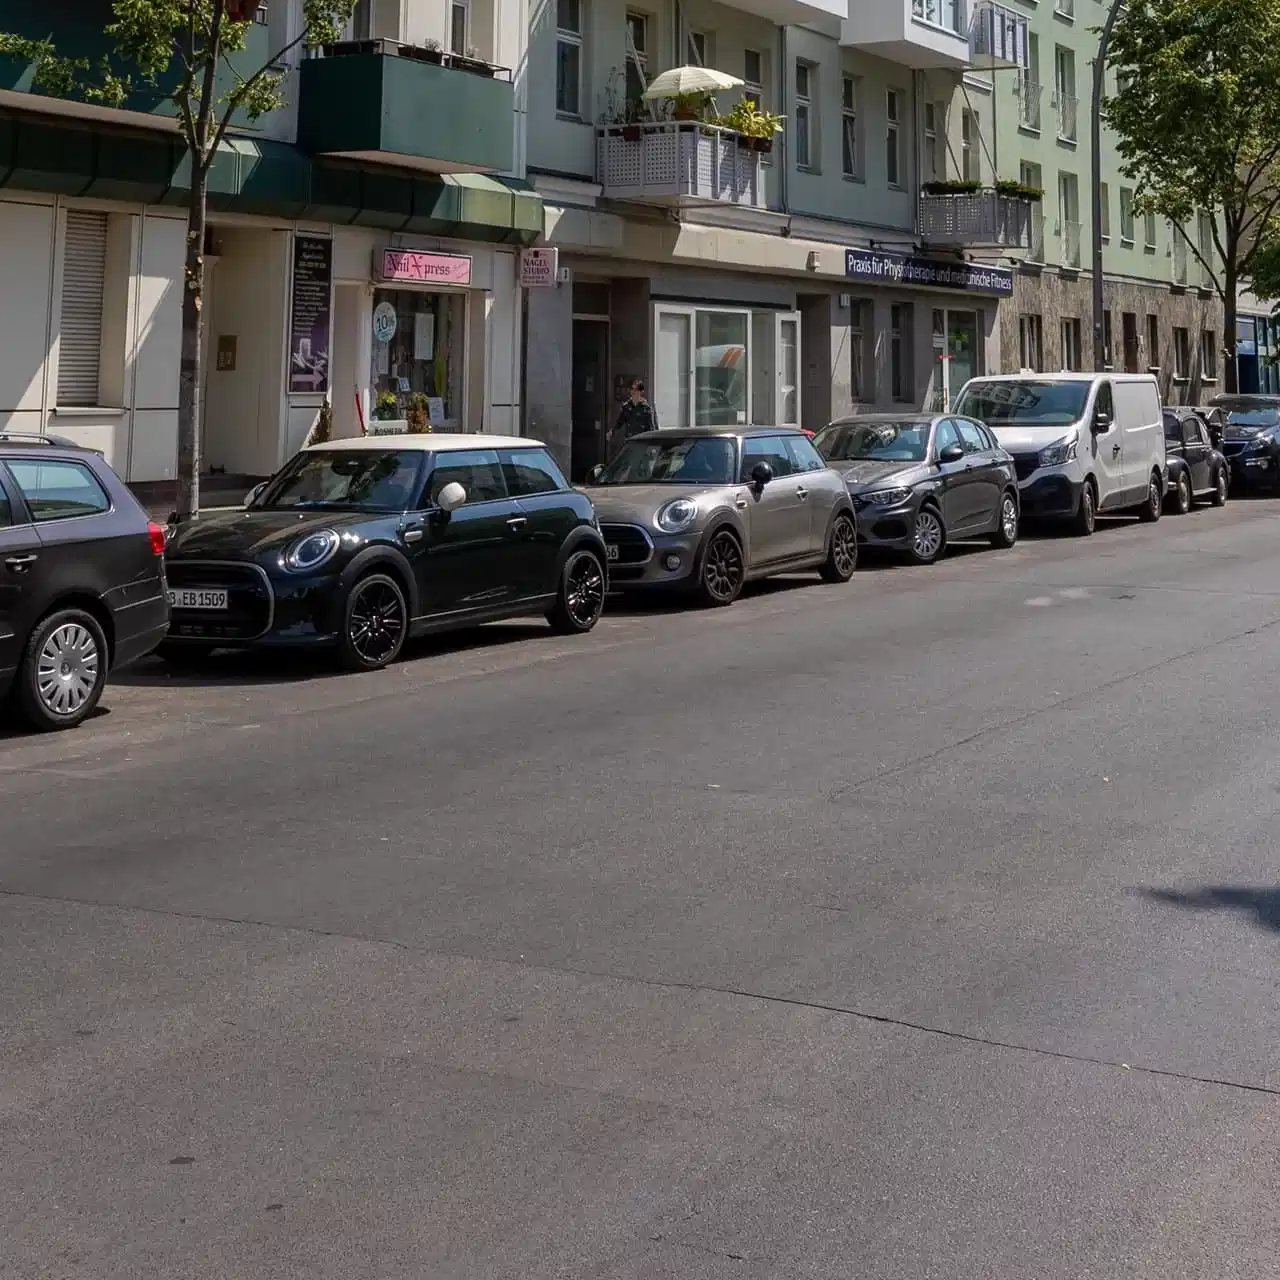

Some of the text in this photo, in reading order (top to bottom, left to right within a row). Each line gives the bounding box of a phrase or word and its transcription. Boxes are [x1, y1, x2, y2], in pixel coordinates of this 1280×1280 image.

[848, 254, 872, 272] Praxis
[872, 256, 883, 274] für
[884, 258, 936, 284] Physiotherapie
[937, 266, 951, 282] und
[991, 272, 1012, 290] Fitness
[182, 592, 196, 606] EB
[199, 592, 226, 607] 1509
